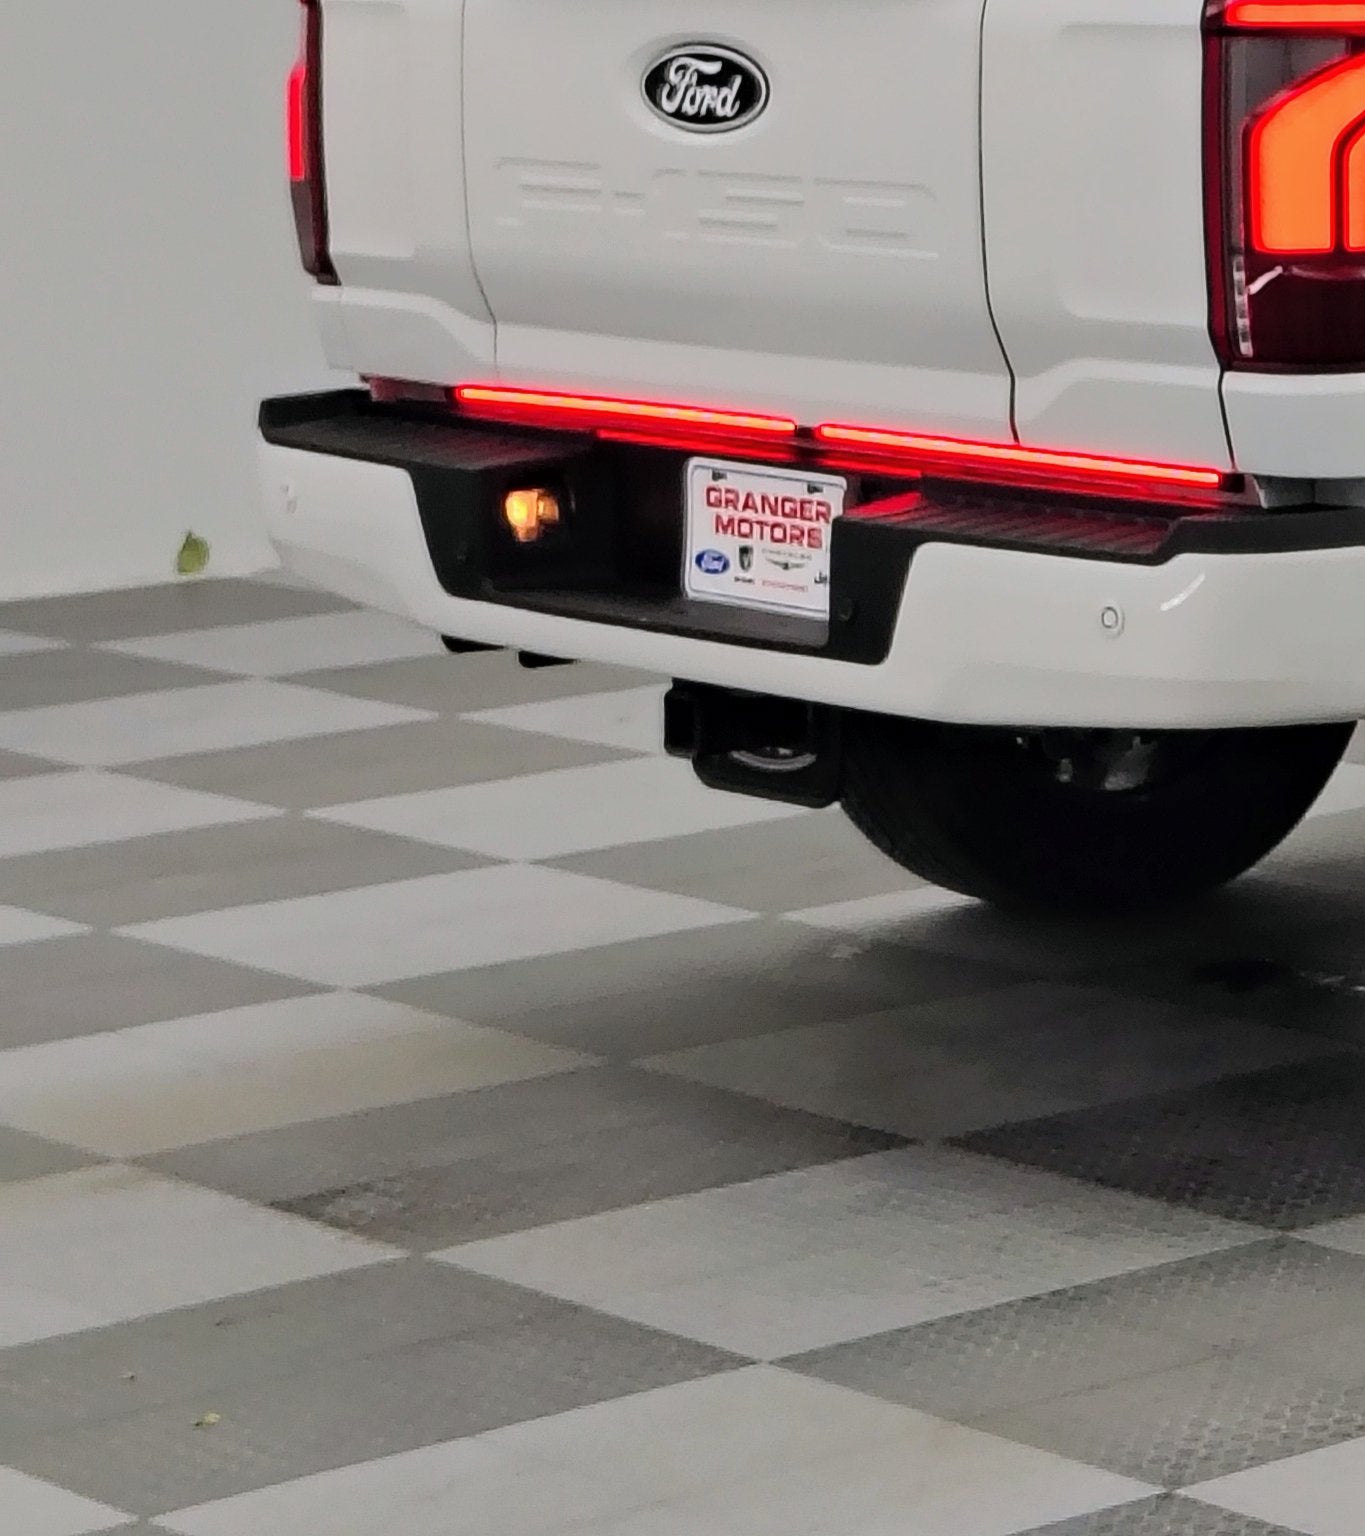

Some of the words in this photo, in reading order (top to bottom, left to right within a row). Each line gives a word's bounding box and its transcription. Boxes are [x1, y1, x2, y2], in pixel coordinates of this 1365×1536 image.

[660, 56, 742, 117] Ford
[706, 486, 832, 523] GRANGER
[715, 515, 823, 549] MOTORS
